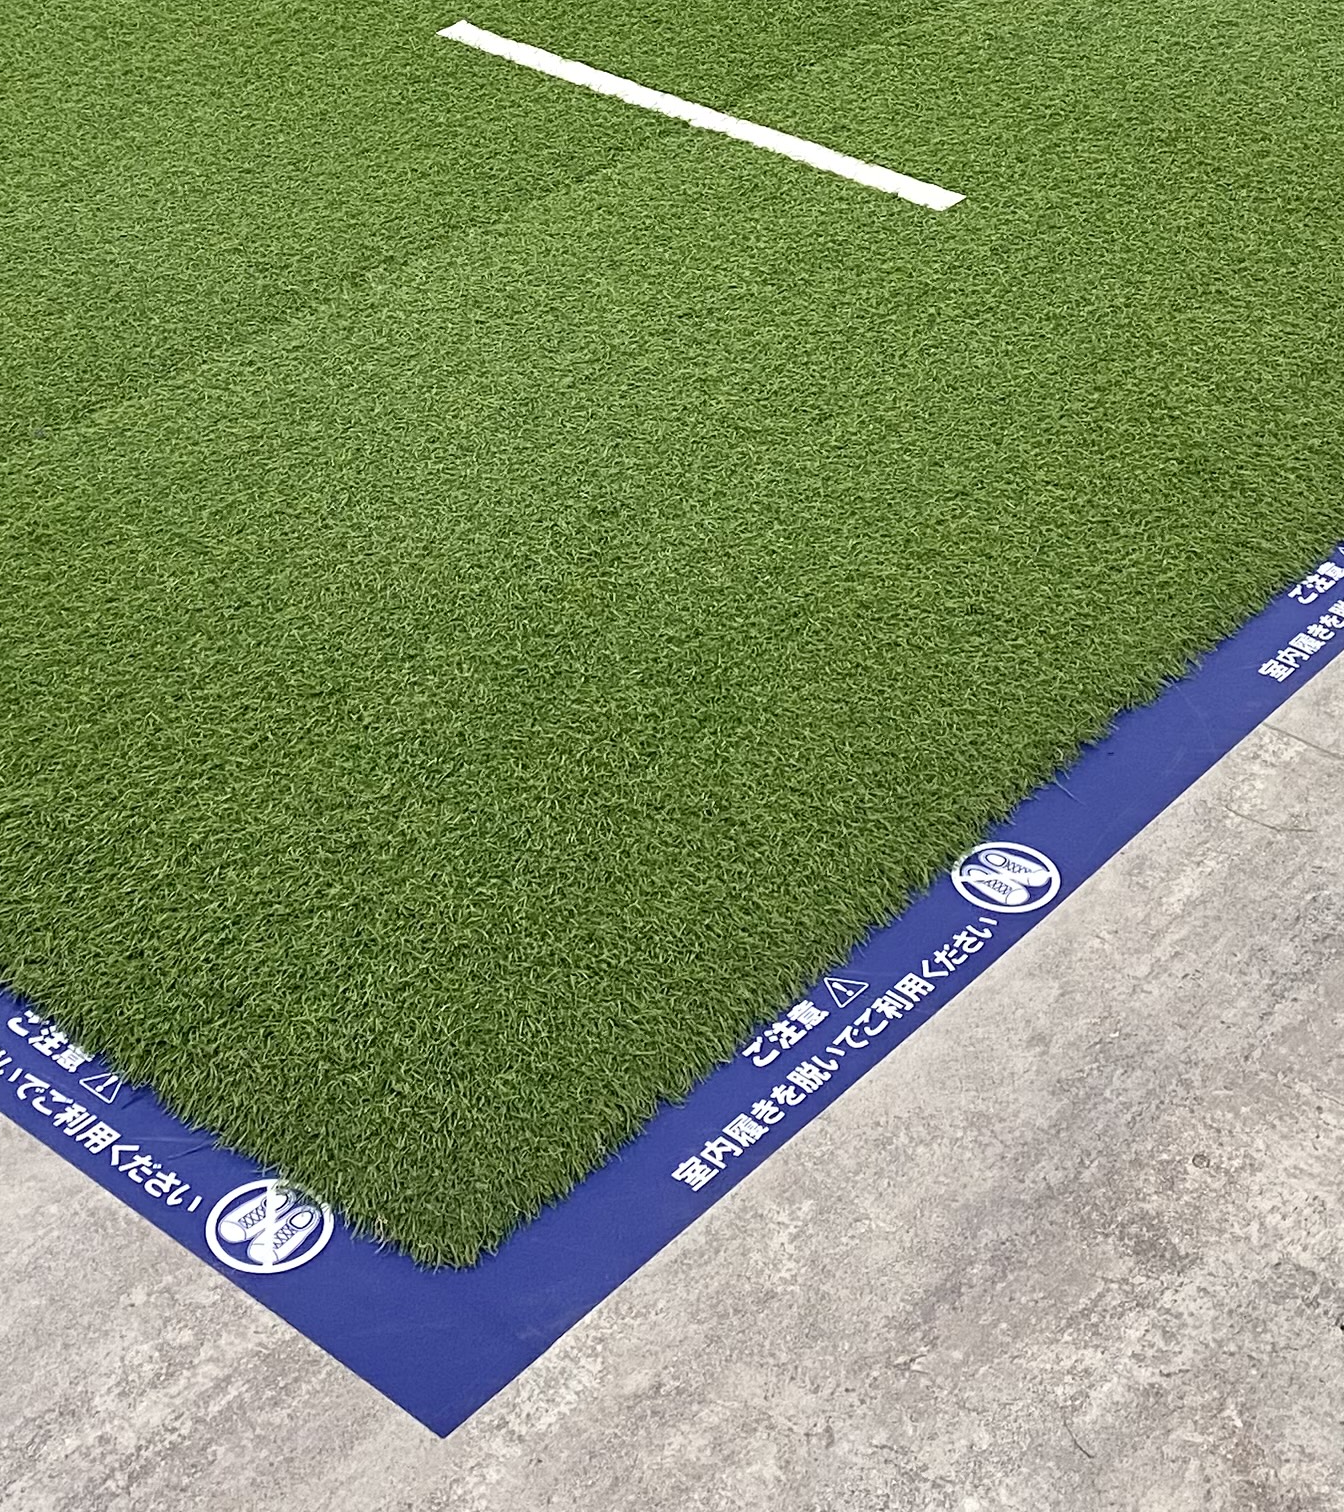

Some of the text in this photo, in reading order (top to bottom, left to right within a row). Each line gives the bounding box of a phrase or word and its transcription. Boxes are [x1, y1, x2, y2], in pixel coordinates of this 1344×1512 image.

[7, 1010, 96, 1073] ご注意
[671, 916, 998, 1192] 室内履きを脱いでご利用ください
[742, 999, 830, 1067] ご注意
